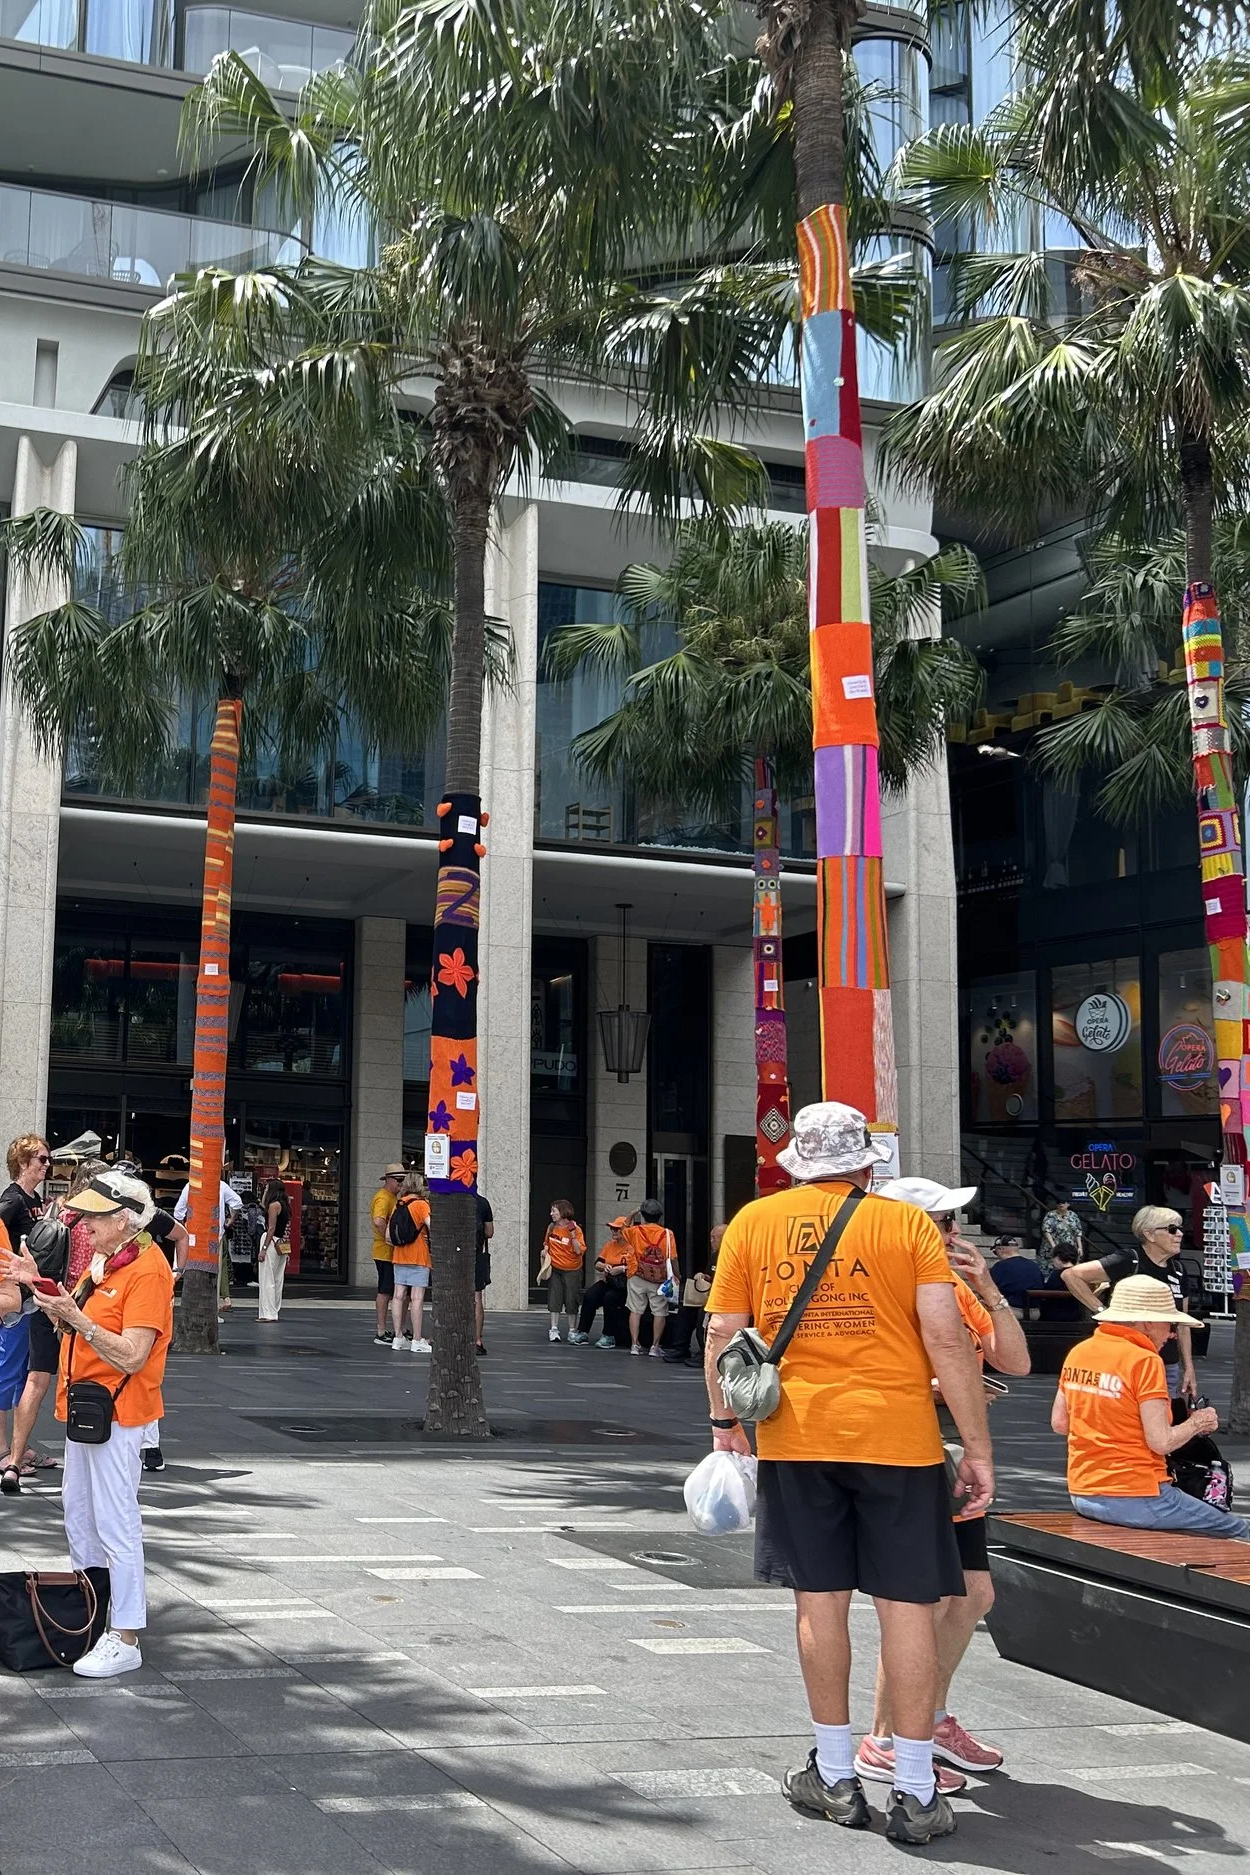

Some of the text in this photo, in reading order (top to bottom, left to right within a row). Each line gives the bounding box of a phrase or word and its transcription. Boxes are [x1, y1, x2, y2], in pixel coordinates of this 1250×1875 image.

[1082, 1025, 1111, 1045] Gelato
[1070, 1152, 1133, 1171] GELATO
[615, 1188, 629, 1201] 71
[820, 1282, 835, 1292] OF
[764, 1292, 869, 1308] WOLGONG INC
[820, 1309, 875, 1318] INTERNATIONAL
[832, 1319, 875, 1329] WOMEN
[796, 1331, 825, 1339] SERVICE
[834, 1328, 877, 1337] ADVOCACY
[1064, 1367, 1093, 1386] ZONTA
[1101, 1372, 1123, 1392] NO
